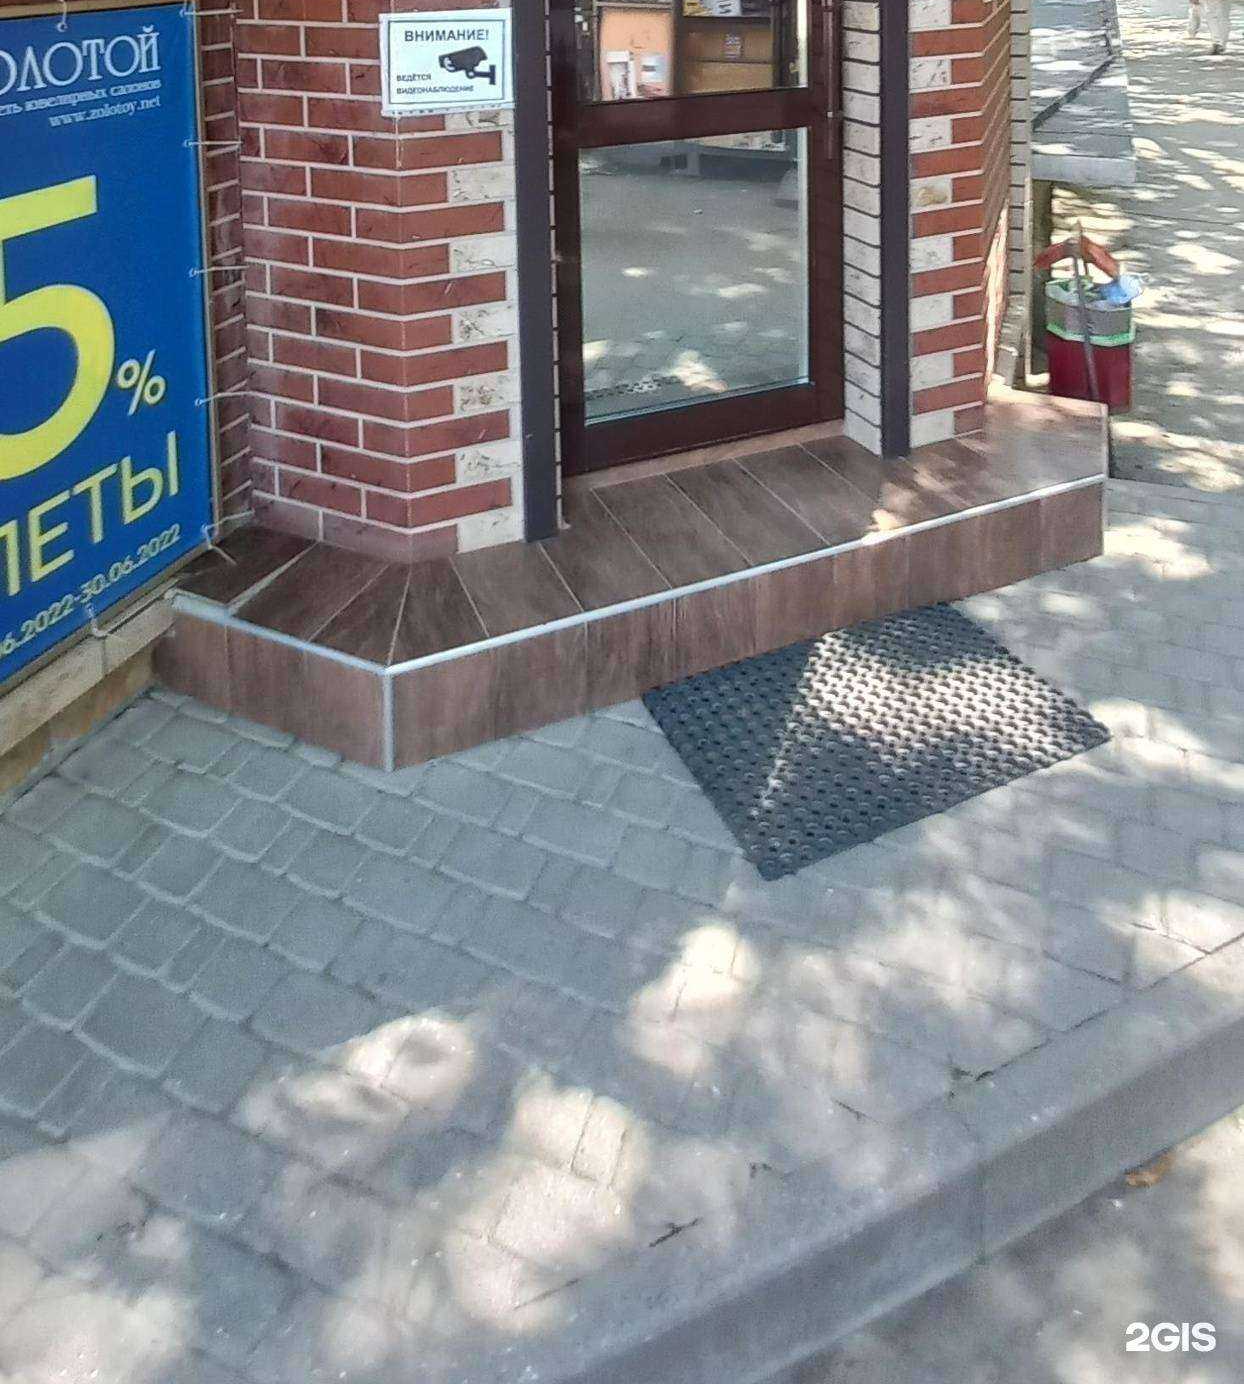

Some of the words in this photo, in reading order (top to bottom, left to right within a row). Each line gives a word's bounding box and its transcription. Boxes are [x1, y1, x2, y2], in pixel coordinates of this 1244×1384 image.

[404, 29, 489, 42] ВНИМАНИЕ!
[396, 73, 431, 82] ВЕДЁТСЯ
[25, 88, 107, 111] ювелирных
[111, 79, 161, 96] салонов
[396, 85, 473, 94] ВИДЕОНАБЛЮДЕНИЕ
[50, 95, 160, 127] www.zolotoy.net
[0, 523, 181, 657] 6.2022-30.06.2022
